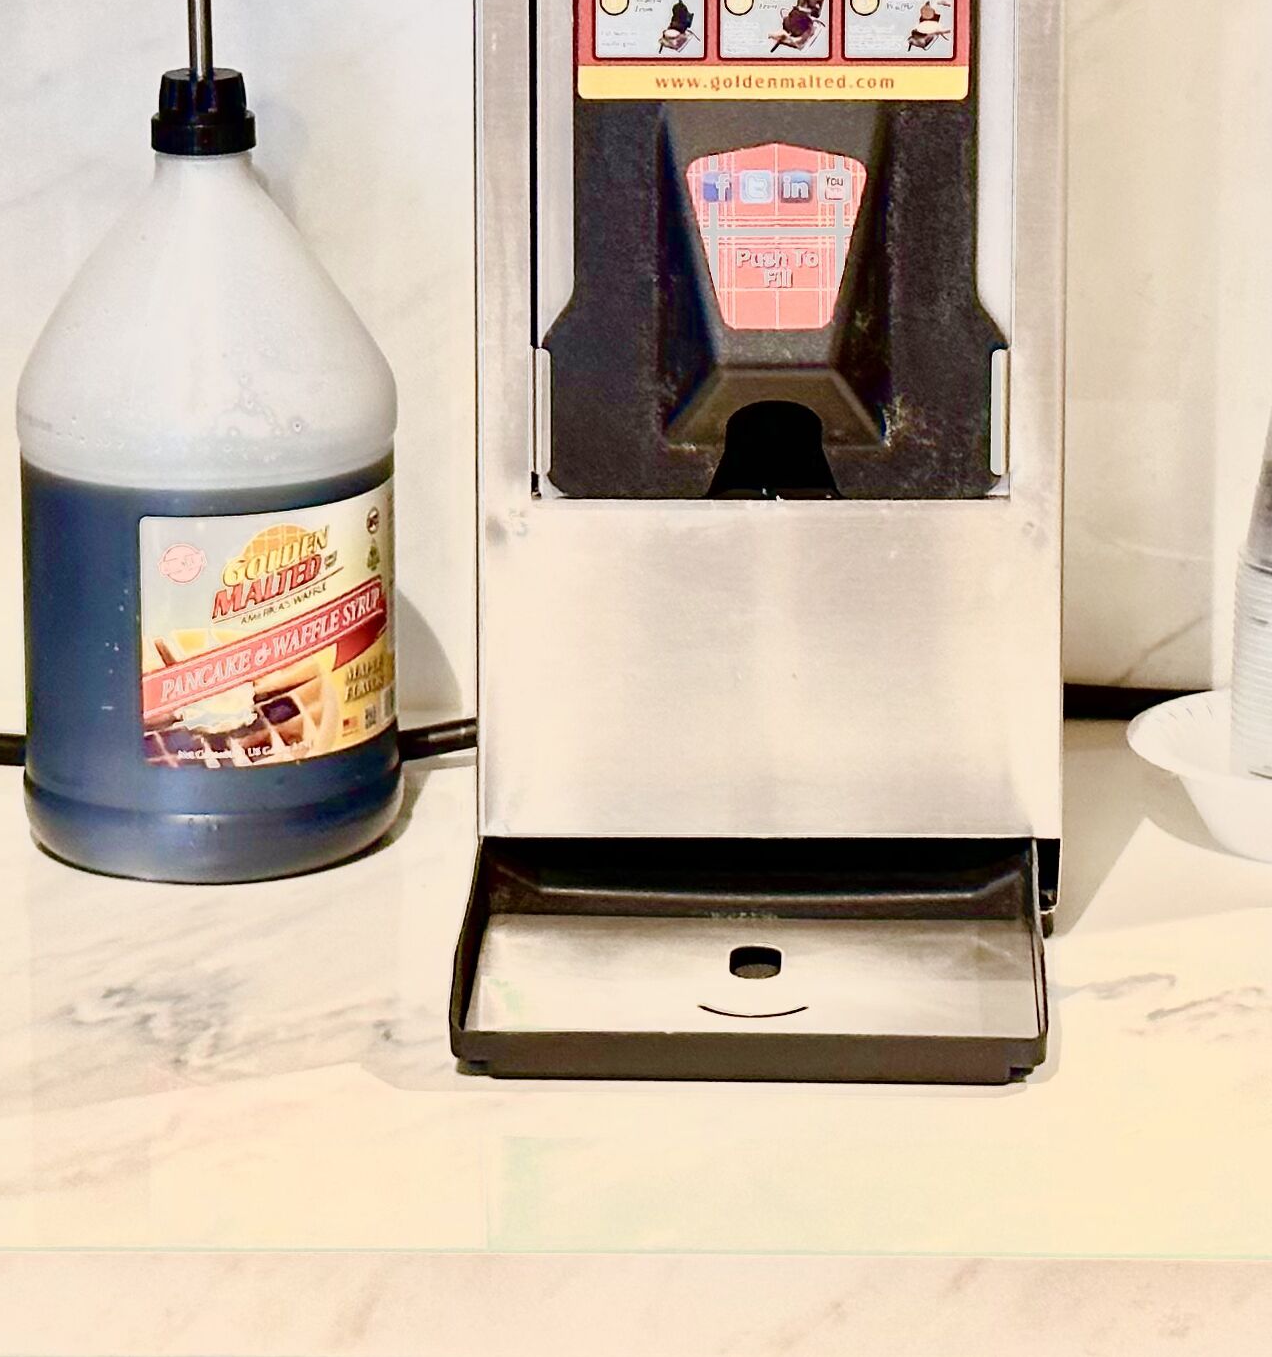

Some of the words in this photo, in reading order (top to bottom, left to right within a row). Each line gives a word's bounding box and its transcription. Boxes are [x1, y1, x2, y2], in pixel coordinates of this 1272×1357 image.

[655, 74, 895, 91] www.goldenmalted.com
[782, 176, 809, 199] in
[825, 175, 844, 188] You
[736, 248, 789, 268] Push
[794, 248, 819, 268] To
[763, 268, 793, 288] Fill
[223, 524, 330, 587] GOLDEN
[211, 554, 321, 619] MALTED
[160, 646, 252, 704] PANCAKE
[254, 645, 272, 665] &
[272, 609, 341, 658] WAFFLE
[341, 586, 381, 627] SYRUP
